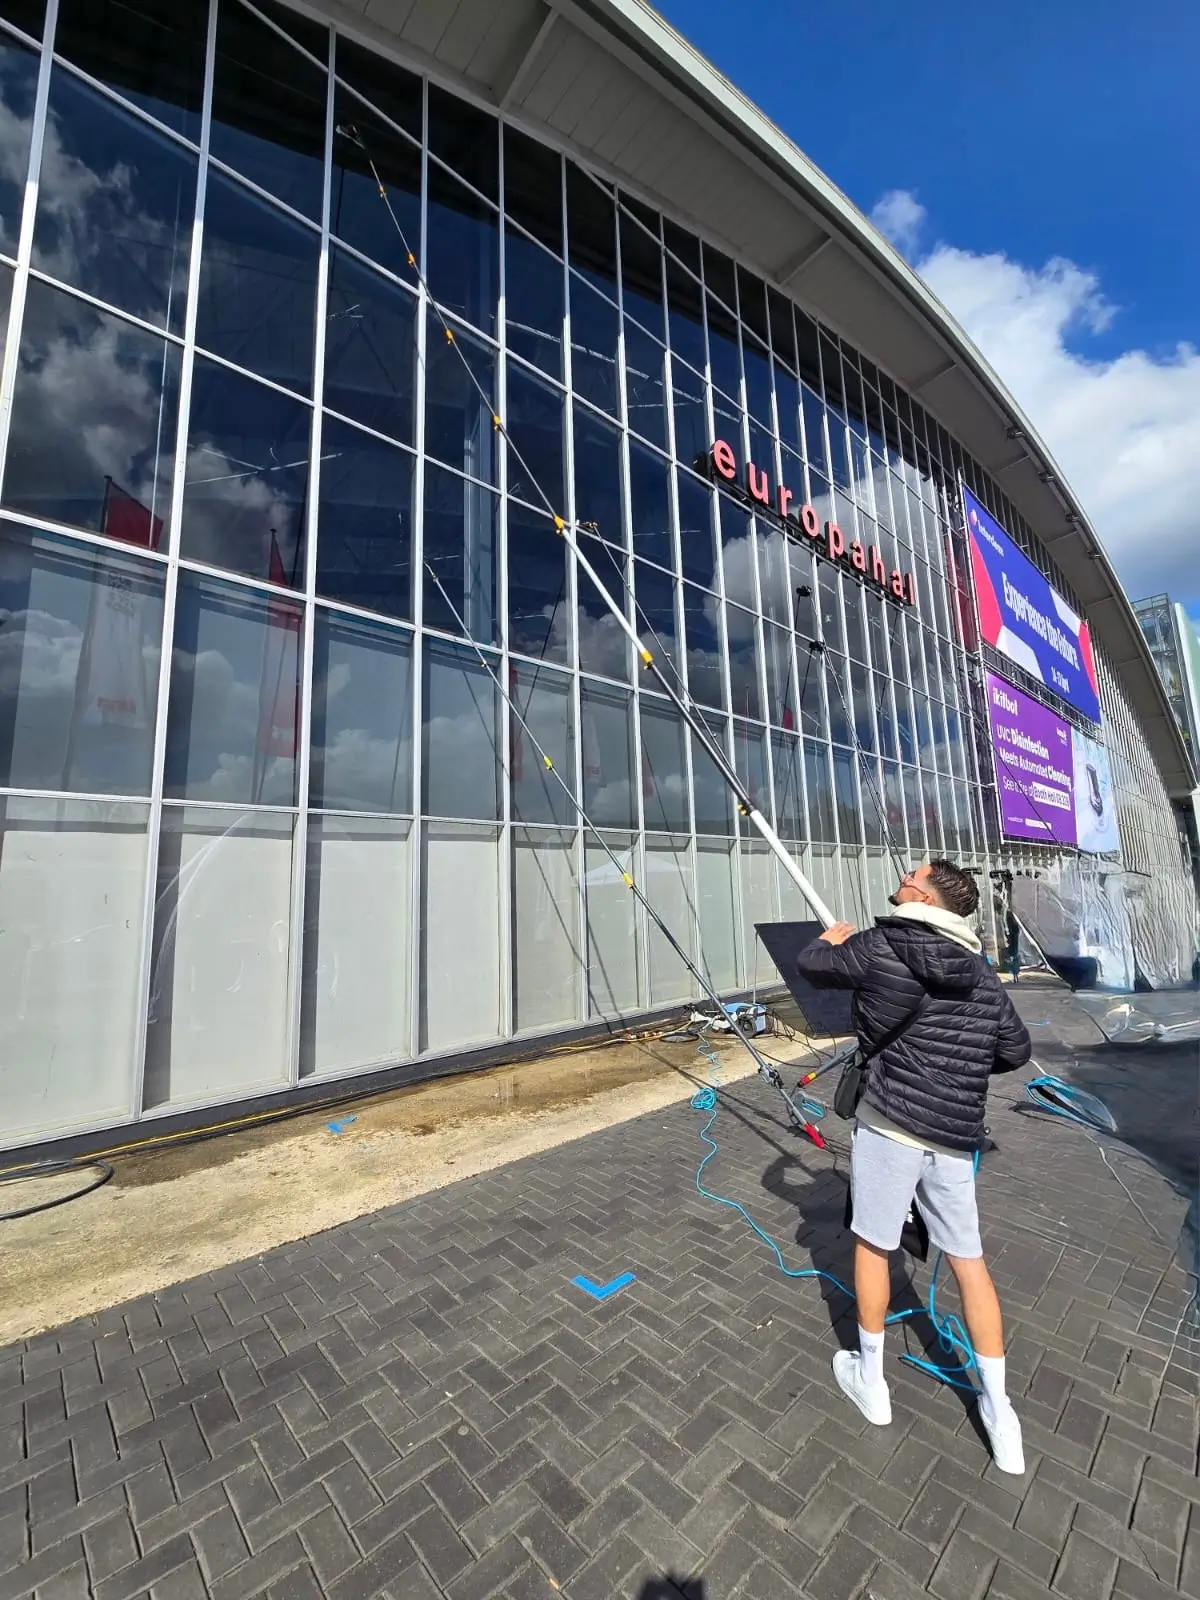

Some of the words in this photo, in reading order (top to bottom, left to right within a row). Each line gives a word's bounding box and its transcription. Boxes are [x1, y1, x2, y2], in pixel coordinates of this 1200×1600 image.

[711, 440, 915, 606] europahal
[1002, 571, 1048, 641] Experience
[1046, 615, 1060, 653] the
[997, 723, 1011, 743] UVC
[1010, 728, 1050, 761] Disinfection
[999, 747, 1019, 768] Meets
[1019, 755, 1049, 779] Automated
[1047, 765, 1072, 792] Cleaning
[1003, 776, 1015, 791] See
